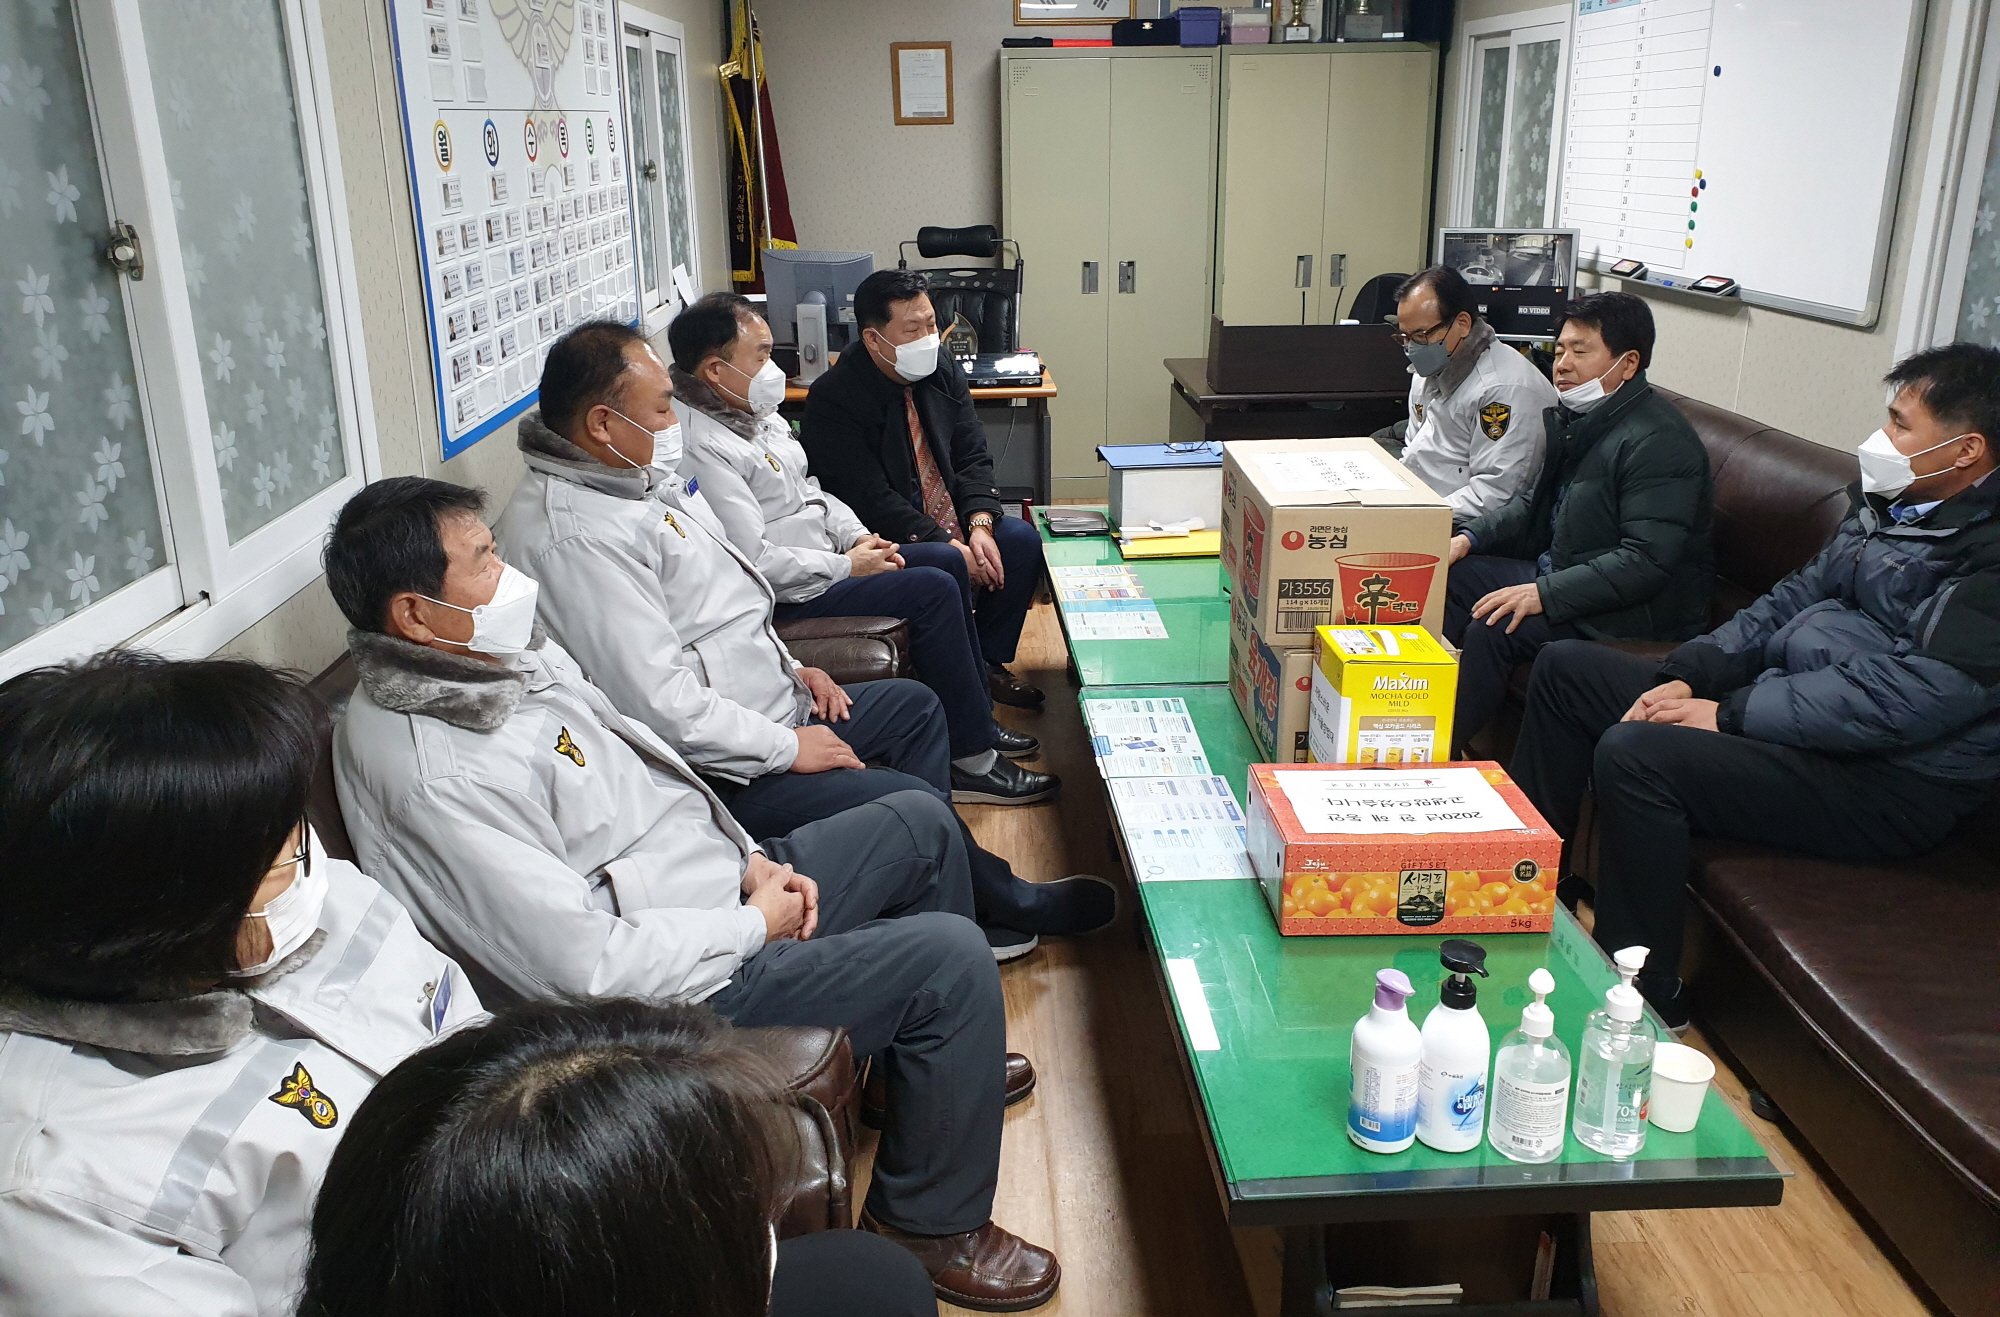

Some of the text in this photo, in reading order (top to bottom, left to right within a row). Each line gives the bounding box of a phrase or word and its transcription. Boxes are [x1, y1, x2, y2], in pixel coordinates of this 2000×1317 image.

[437, 130, 450, 163] 월
[486, 128, 497, 158] 화
[527, 126, 534, 154] 수
[1309, 525, 1348, 534] 라면은 농심
[1308, 534, 1348, 549] 농심
[1281, 581, 1331, 596] 가3556
[1356, 573, 1399, 625] 辛
[1392, 602, 1418, 612] 라면
[1247, 631, 1278, 722] 육개장
[1372, 673, 1429, 691] Maxim
[1370, 692, 1429, 700] MOCHA GOLD
[1327, 811, 1483, 822] 2020년 한 해 동안
[1429, 861, 1448, 869] SET
[1403, 871, 1443, 886] 서귀포
